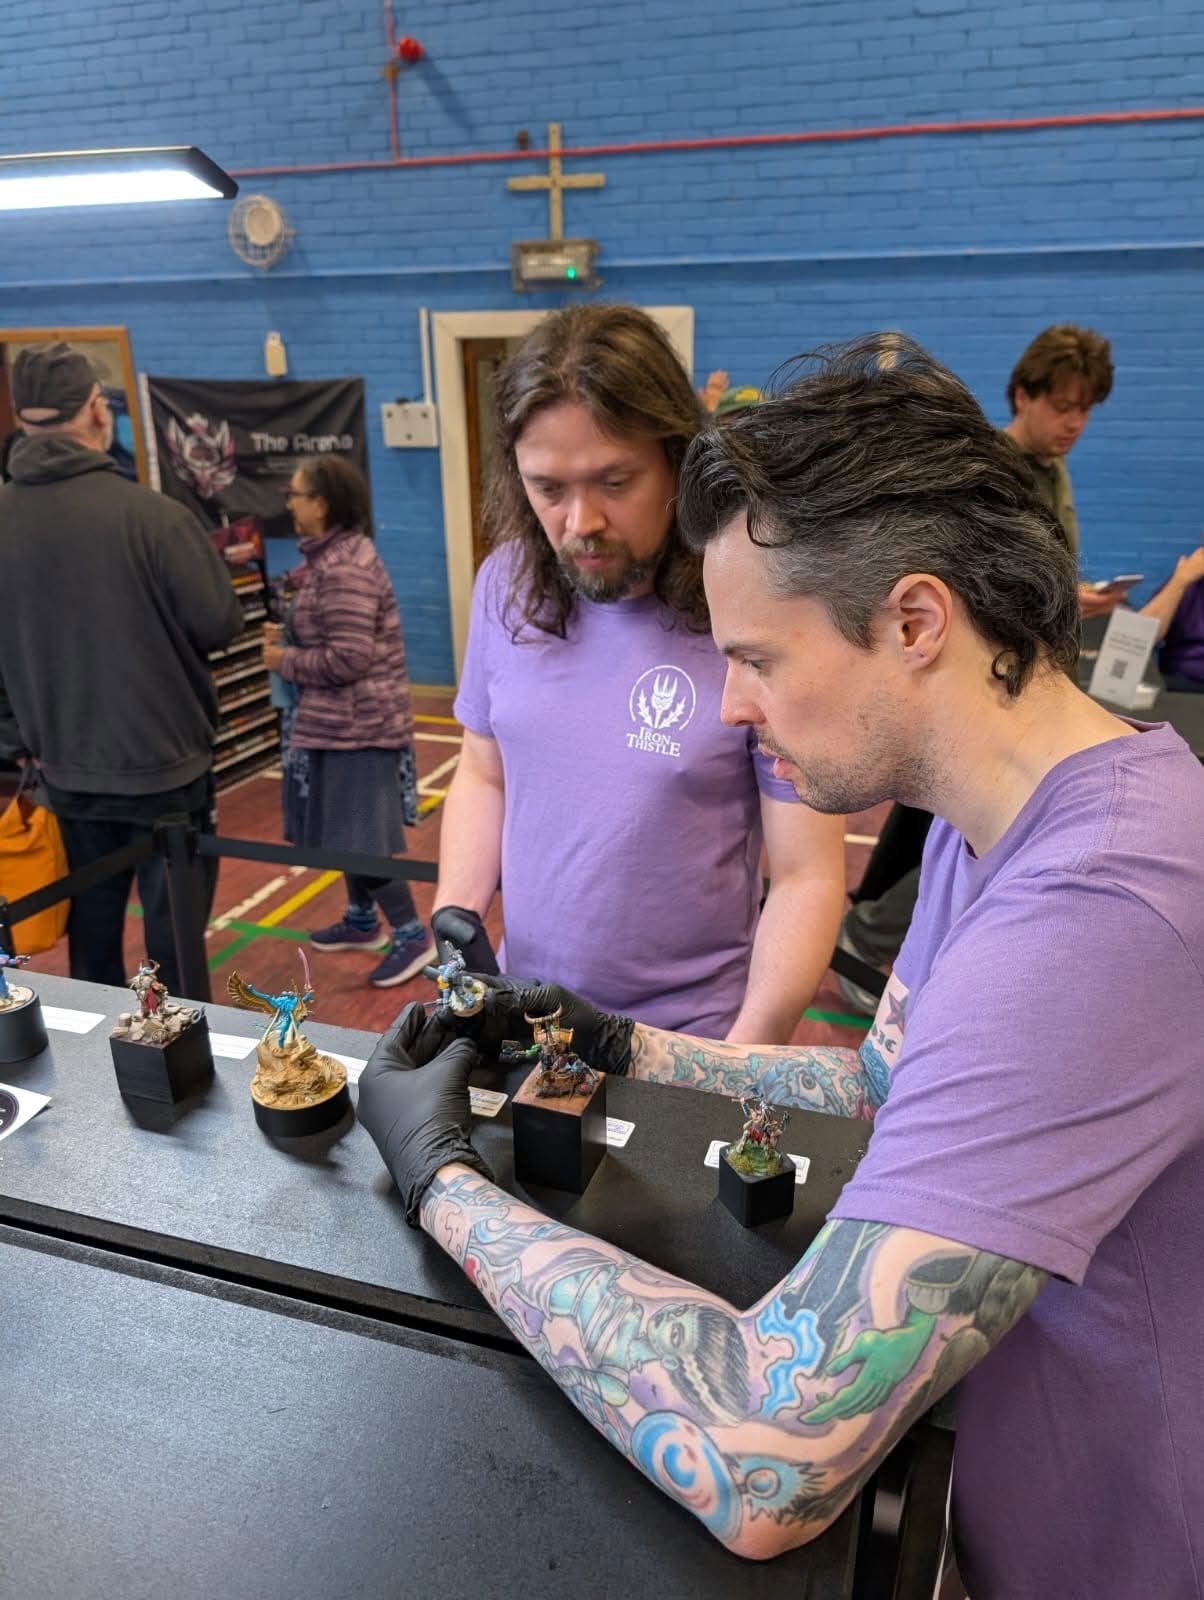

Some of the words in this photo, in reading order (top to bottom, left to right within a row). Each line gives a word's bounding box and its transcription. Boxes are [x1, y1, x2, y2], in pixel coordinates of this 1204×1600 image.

[250, 432, 288, 452] The
[626, 733, 681, 757] THISTLE
[640, 727, 671, 745] IRON
